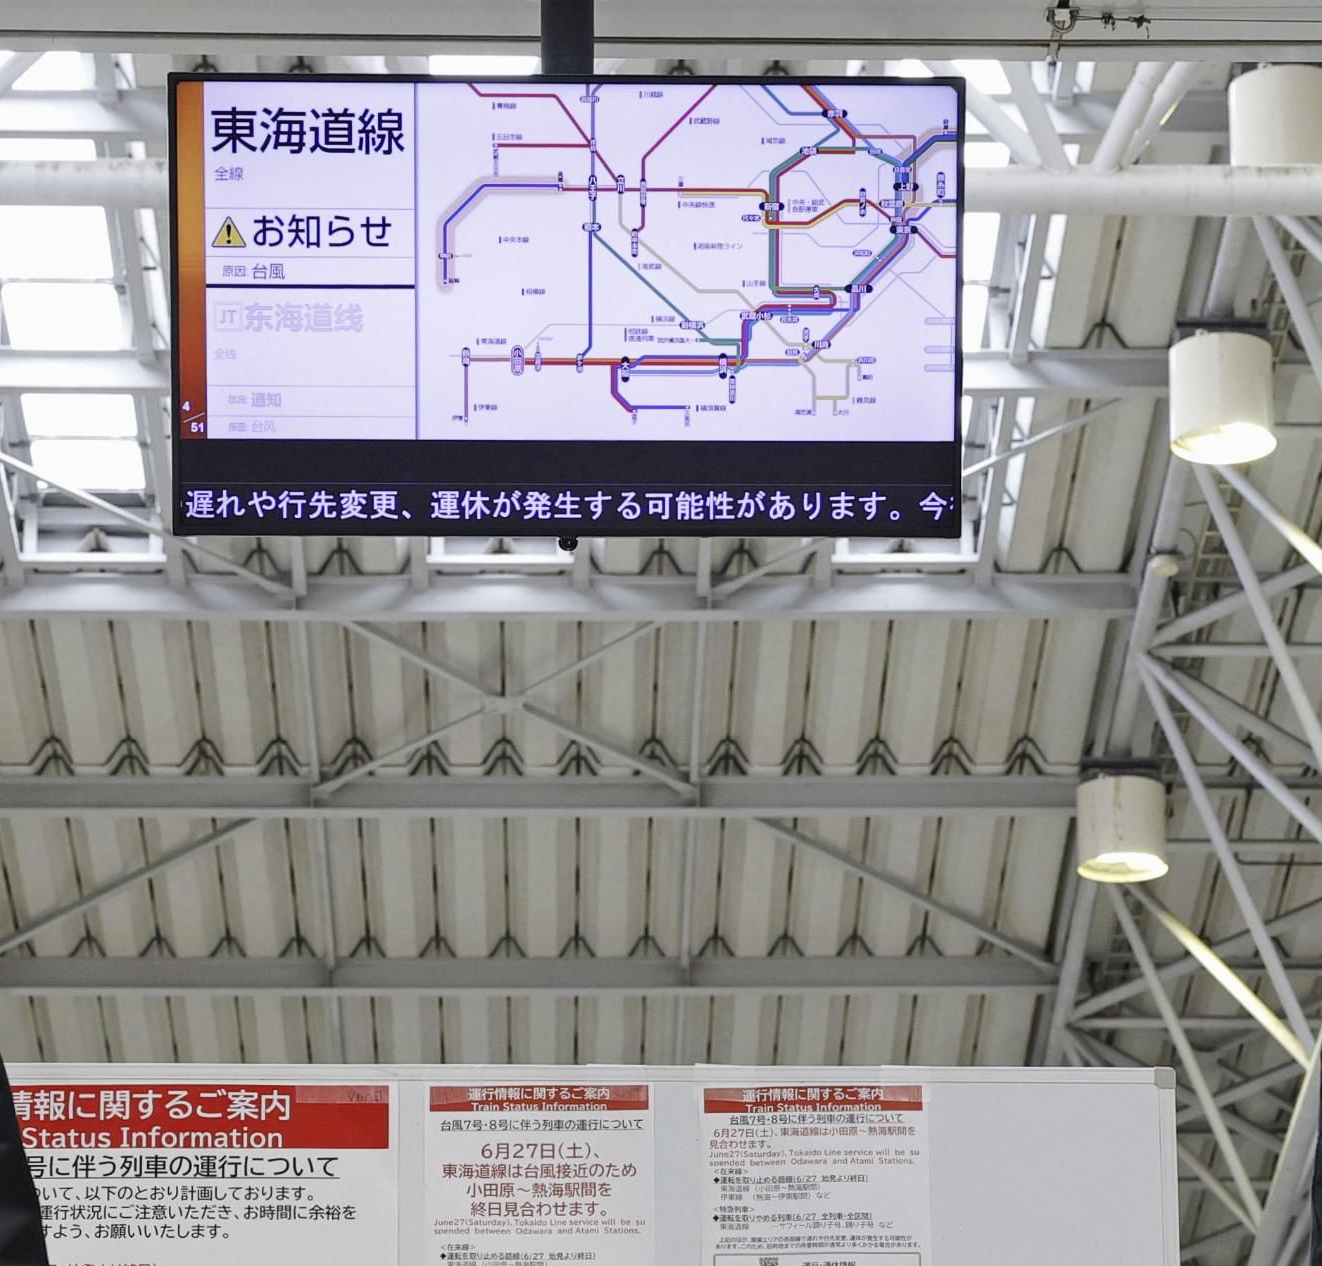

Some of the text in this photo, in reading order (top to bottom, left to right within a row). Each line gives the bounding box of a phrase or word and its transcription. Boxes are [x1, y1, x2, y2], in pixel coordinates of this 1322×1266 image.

[211, 107, 405, 155] 東海道線
[214, 166, 244, 181] 全線
[253, 214, 392, 248] お知らせ
[252, 263, 285, 280] 台風
[244, 302, 364, 333] 东海道线
[182, 401, 191, 412] 4
[251, 392, 282, 408] 通知
[190, 422, 205, 433] 51
[185, 489, 955, 521] 遅れや行先変更、運休が発生する可能性があります。今
[468, 1087, 611, 1100] 運行情報に関するご案内
[741, 1087, 885, 1102] 運行情報に関するご案内
[471, 1101, 607, 1111] Train Status Information
[745, 1102, 882, 1113] Train Status Information
[440, 1118, 645, 1131] 台風7号・8号に伴う列車の運行について
[21, 1126, 284, 1149] Status Information
[709, 1139, 772, 1149] 見合わせます。
[27, 1154, 341, 1179] 号に伴う列車の運行について
[442, 1163, 638, 1179] 東海道線は台風接近のため
[466, 1182, 613, 1198] 小田原～熱海駅間を
[470, 1201, 609, 1217] 終日見合わせます。
[549, 1218, 567, 1226] Line
[569, 1218, 599, 1226] service
[601, 1217, 617, 1225] will
[620, 1217, 631, 1225] be
